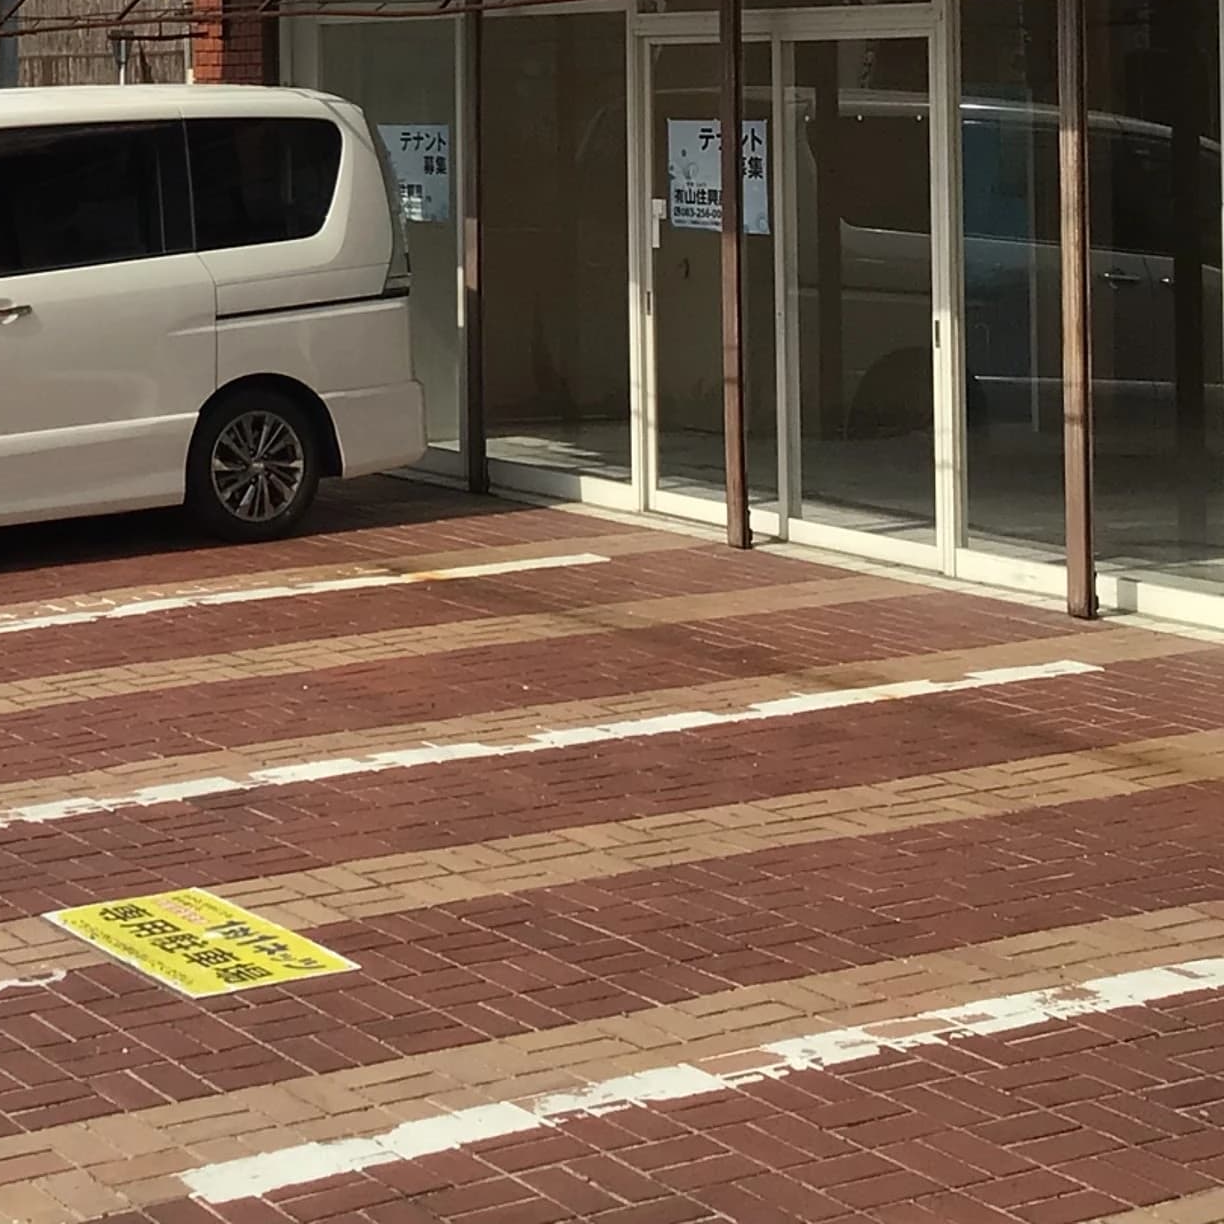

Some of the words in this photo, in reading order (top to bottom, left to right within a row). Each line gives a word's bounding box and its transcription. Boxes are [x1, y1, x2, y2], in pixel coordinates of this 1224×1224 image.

[400, 131, 447, 152] テナント
[423, 155, 447, 176] 募集
[99, 904, 274, 985] 専用駐車場
